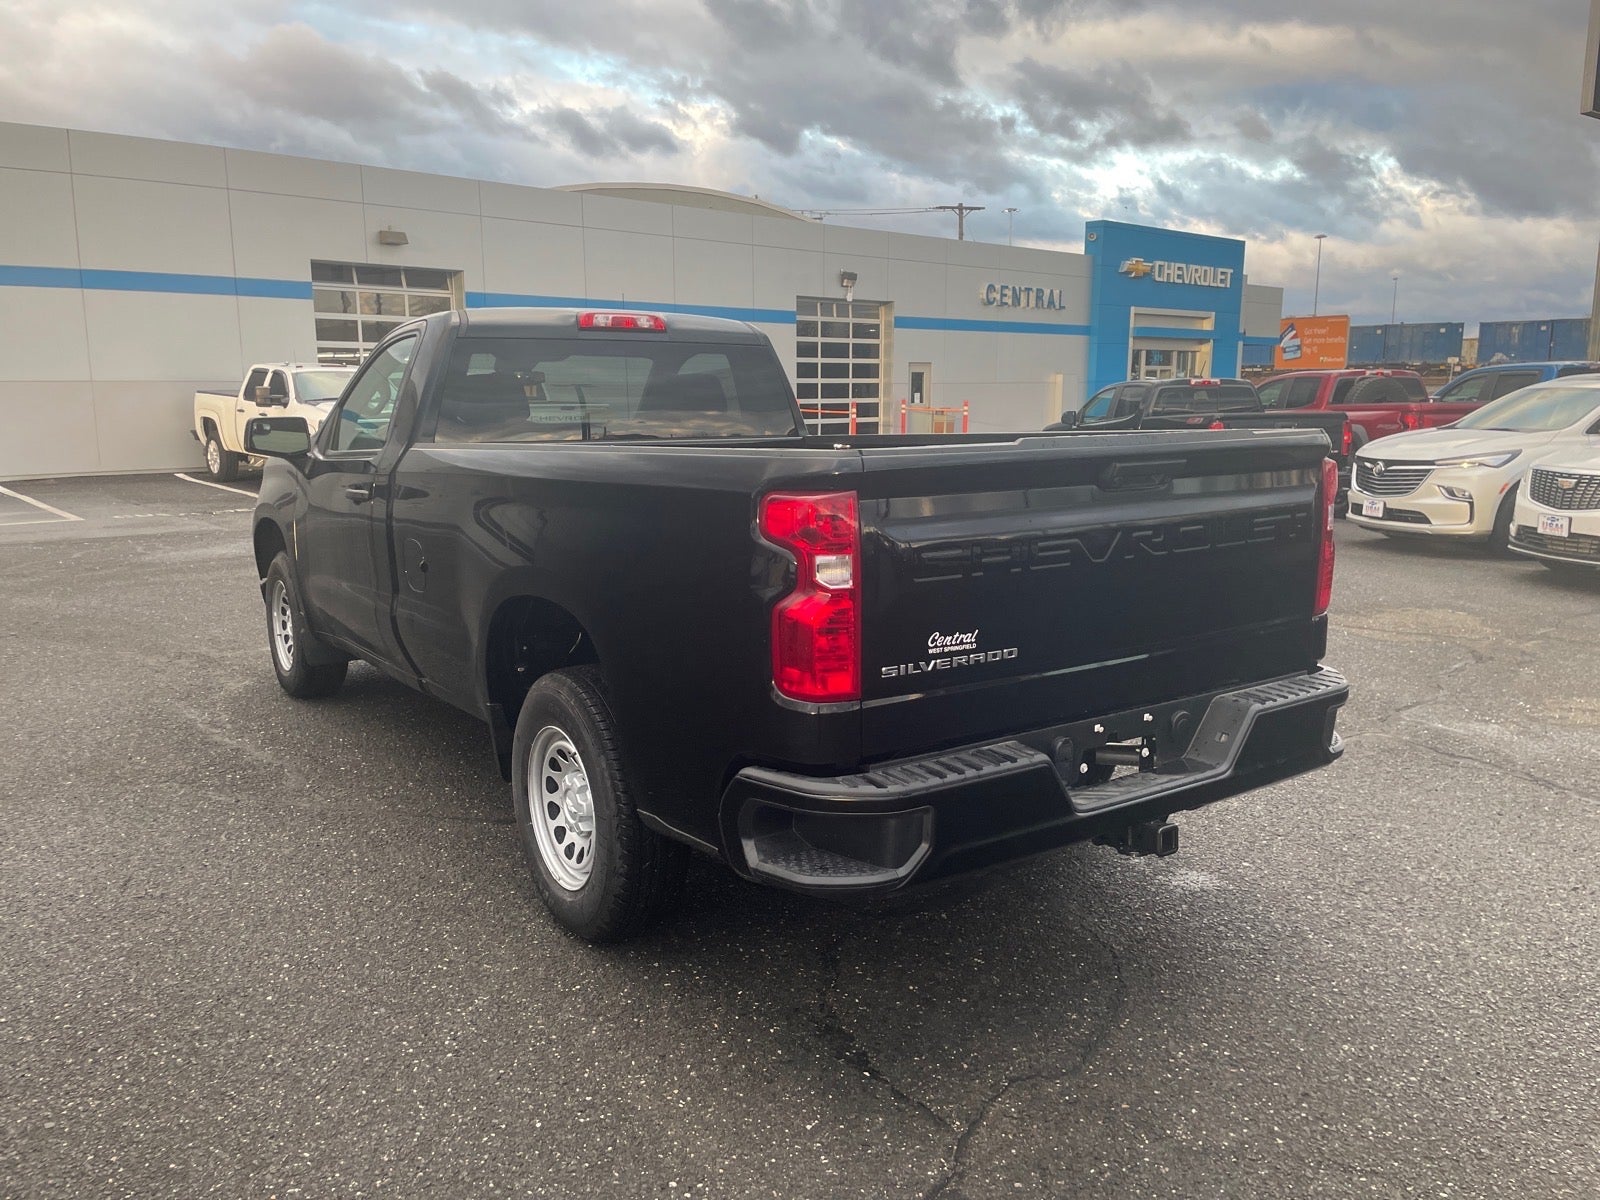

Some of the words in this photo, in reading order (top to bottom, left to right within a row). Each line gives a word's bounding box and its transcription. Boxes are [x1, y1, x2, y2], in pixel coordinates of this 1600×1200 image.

[1153, 260, 1233, 288] CHEVROLET
[984, 283, 1066, 310] CENTRAL
[927, 629, 979, 648] Central
[928, 647, 943, 655] WEST
[943, 643, 977, 653] SPRINGFIELD
[881, 647, 1019, 678] SILVERADO
